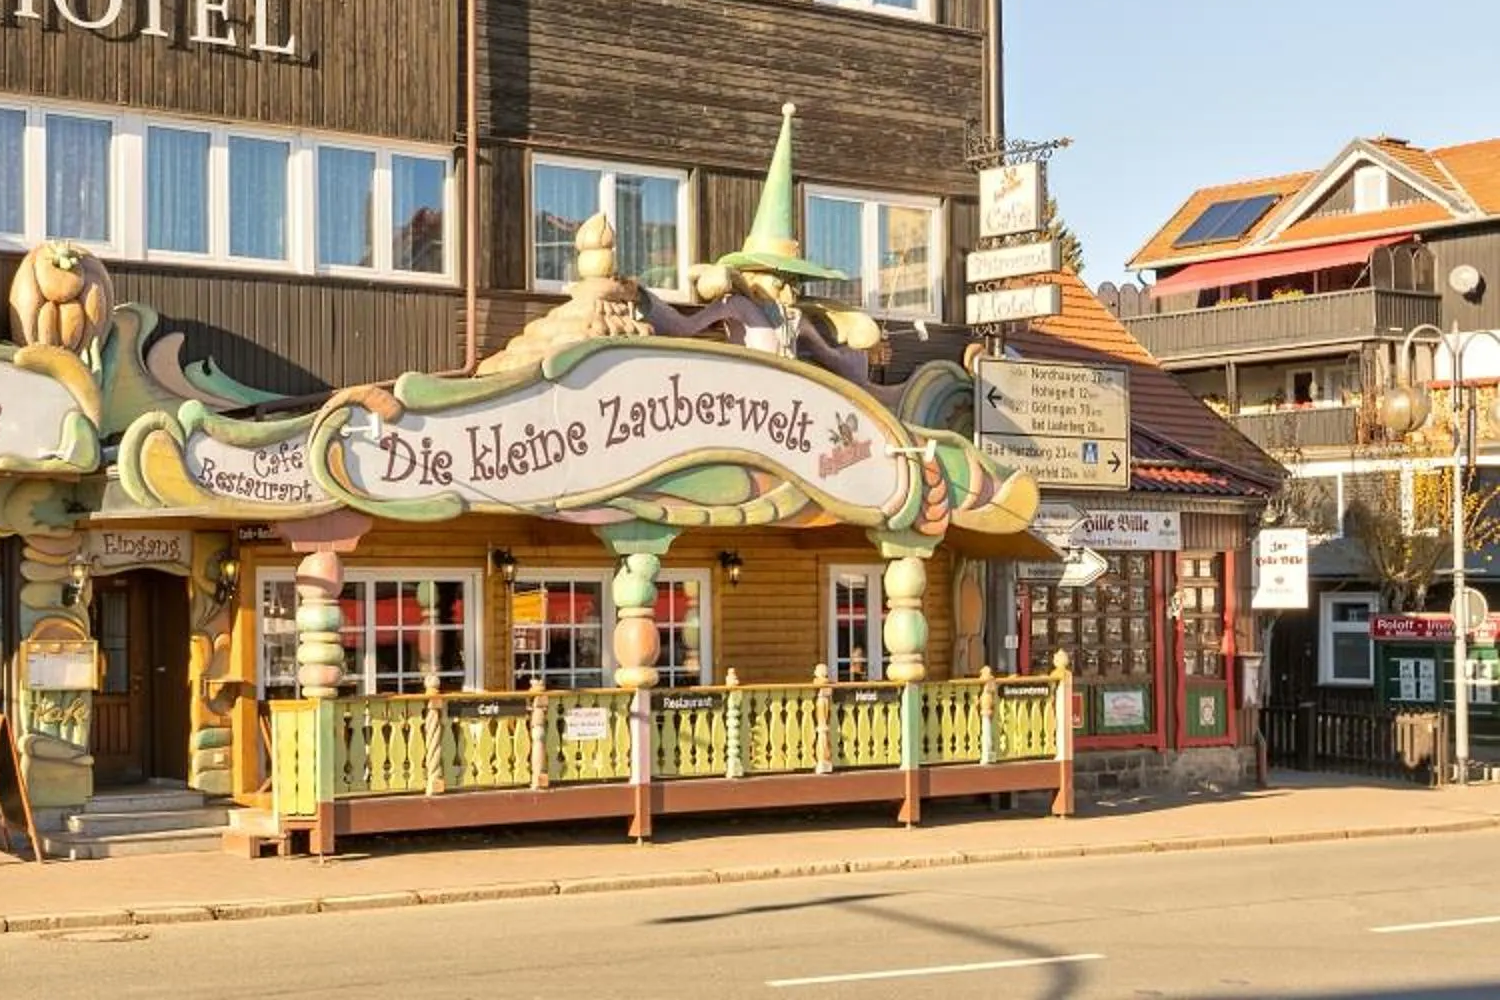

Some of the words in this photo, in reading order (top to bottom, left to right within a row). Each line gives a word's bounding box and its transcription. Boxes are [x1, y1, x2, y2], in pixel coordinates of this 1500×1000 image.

[380, 432, 453, 486] Die
[466, 420, 589, 484] kleine
[599, 374, 814, 453] Zauberwelt
[254, 442, 304, 478] Café
[198, 457, 313, 501] Restaurant
[102, 533, 181, 562] Eingang
[477, 702, 499, 715] Café
[663, 695, 713, 709] Restaurant
